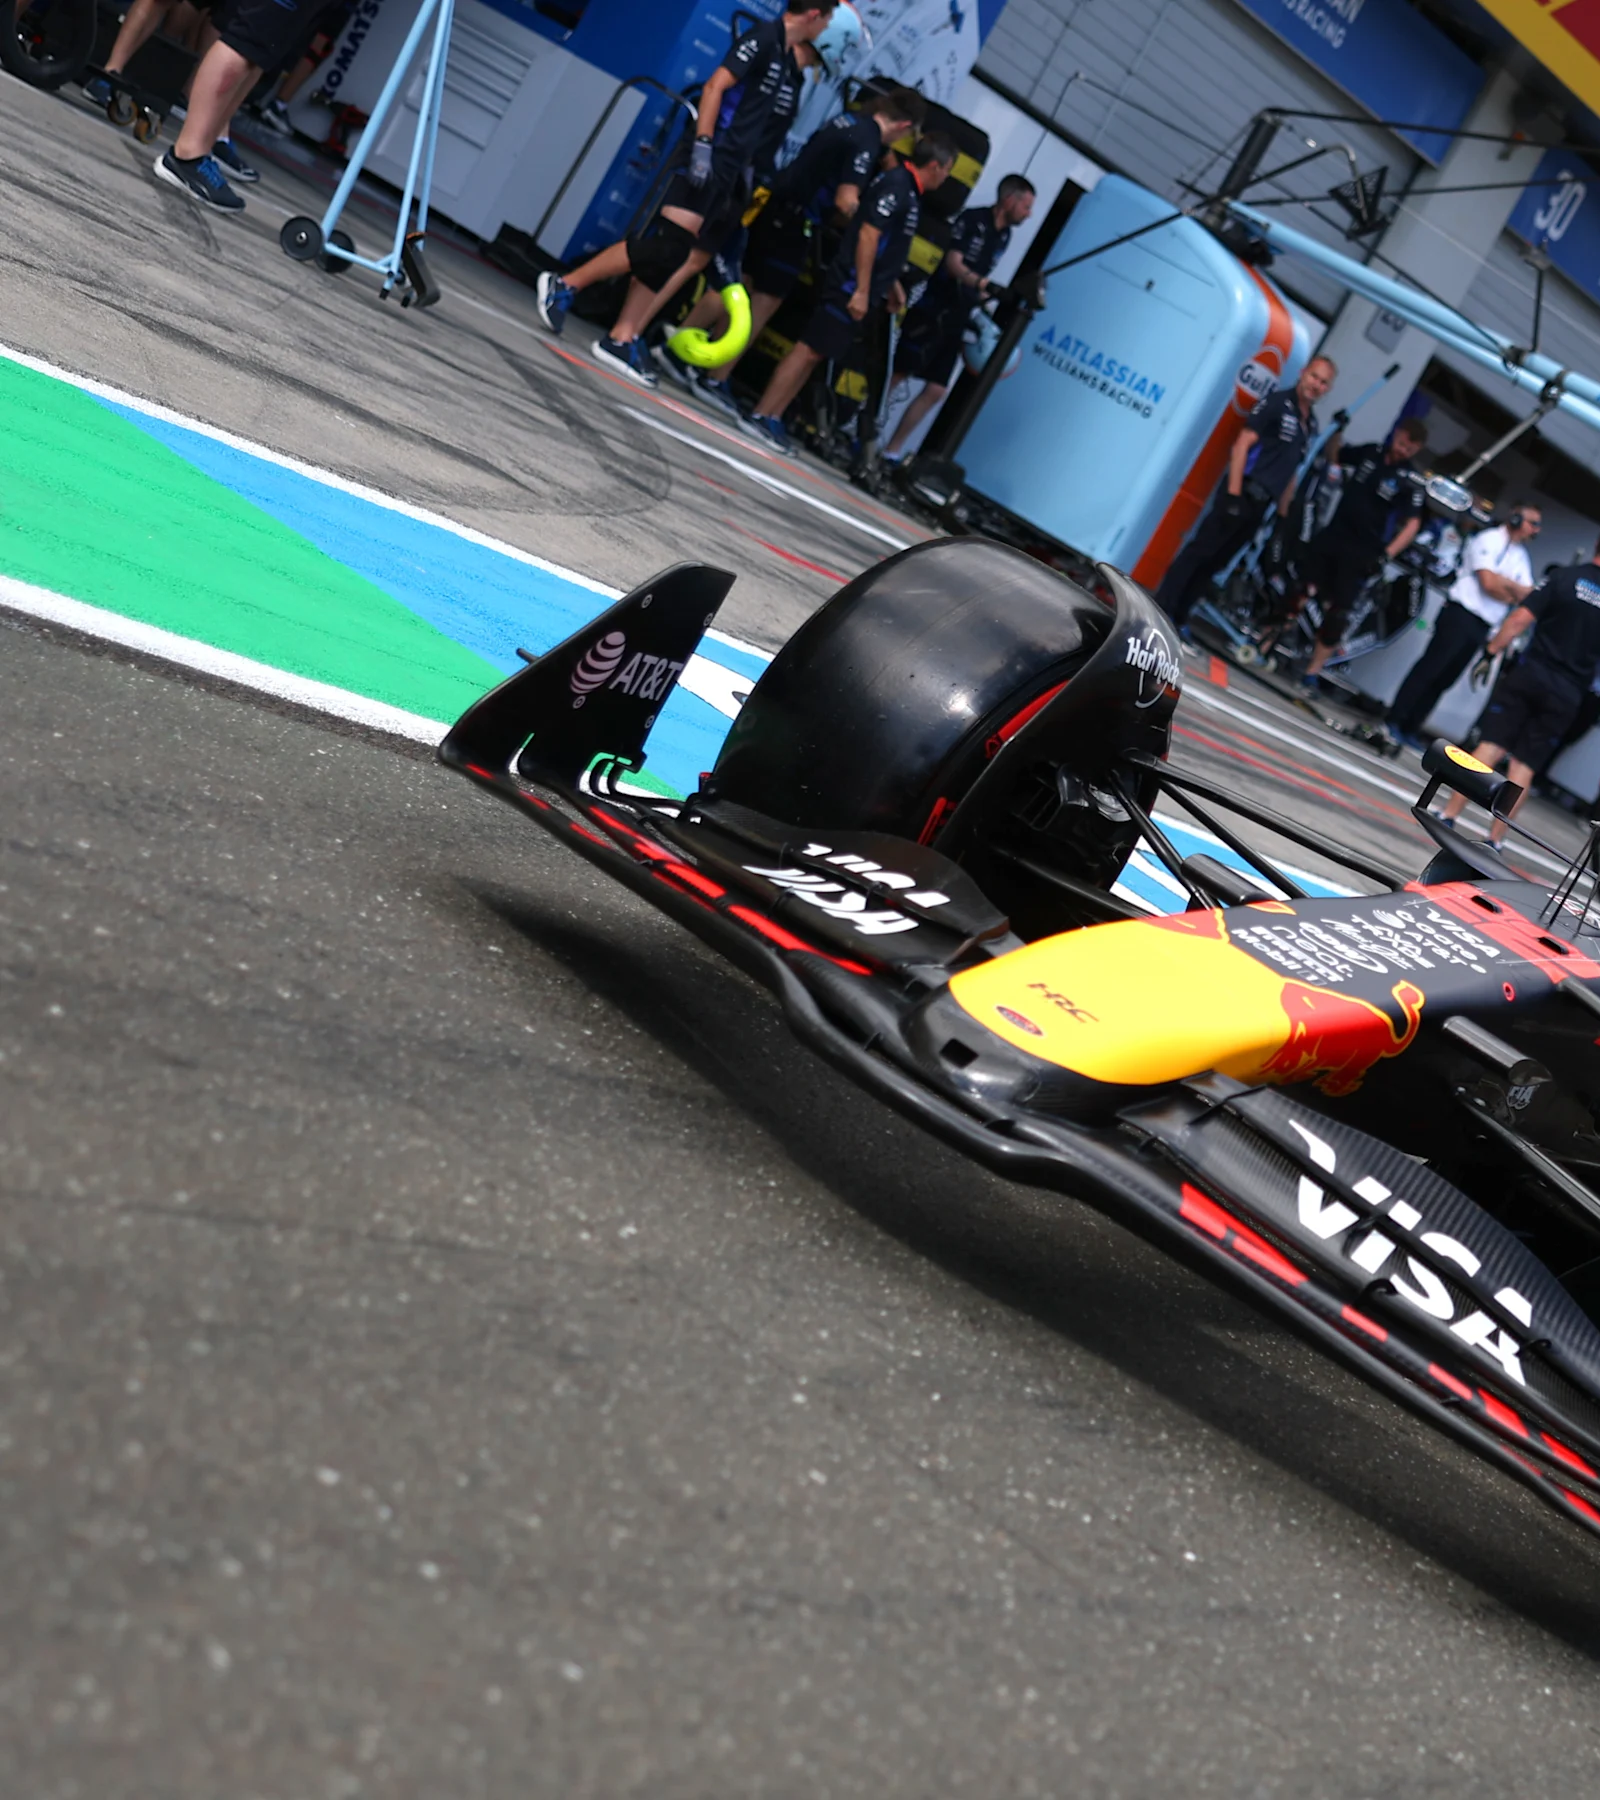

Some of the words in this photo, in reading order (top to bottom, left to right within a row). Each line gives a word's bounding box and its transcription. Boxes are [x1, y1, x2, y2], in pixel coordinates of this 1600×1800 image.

[1534, 170, 1587, 241] 30
[1051, 331, 1166, 404] ATLASSIAN
[1238, 362, 1279, 400] Gulf
[609, 652, 684, 703] AT&T
[1125, 636, 1157, 673] Hard
[1154, 649, 1180, 691] Rock
[1231, 928, 1302, 970] Mobil
[1299, 921, 1369, 962] CDW
[1404, 931, 1468, 966] AT&T
[1426, 907, 1500, 958] VISA
[1026, 982, 1100, 1024] HRC
[1288, 1118, 1527, 1386] VISA
